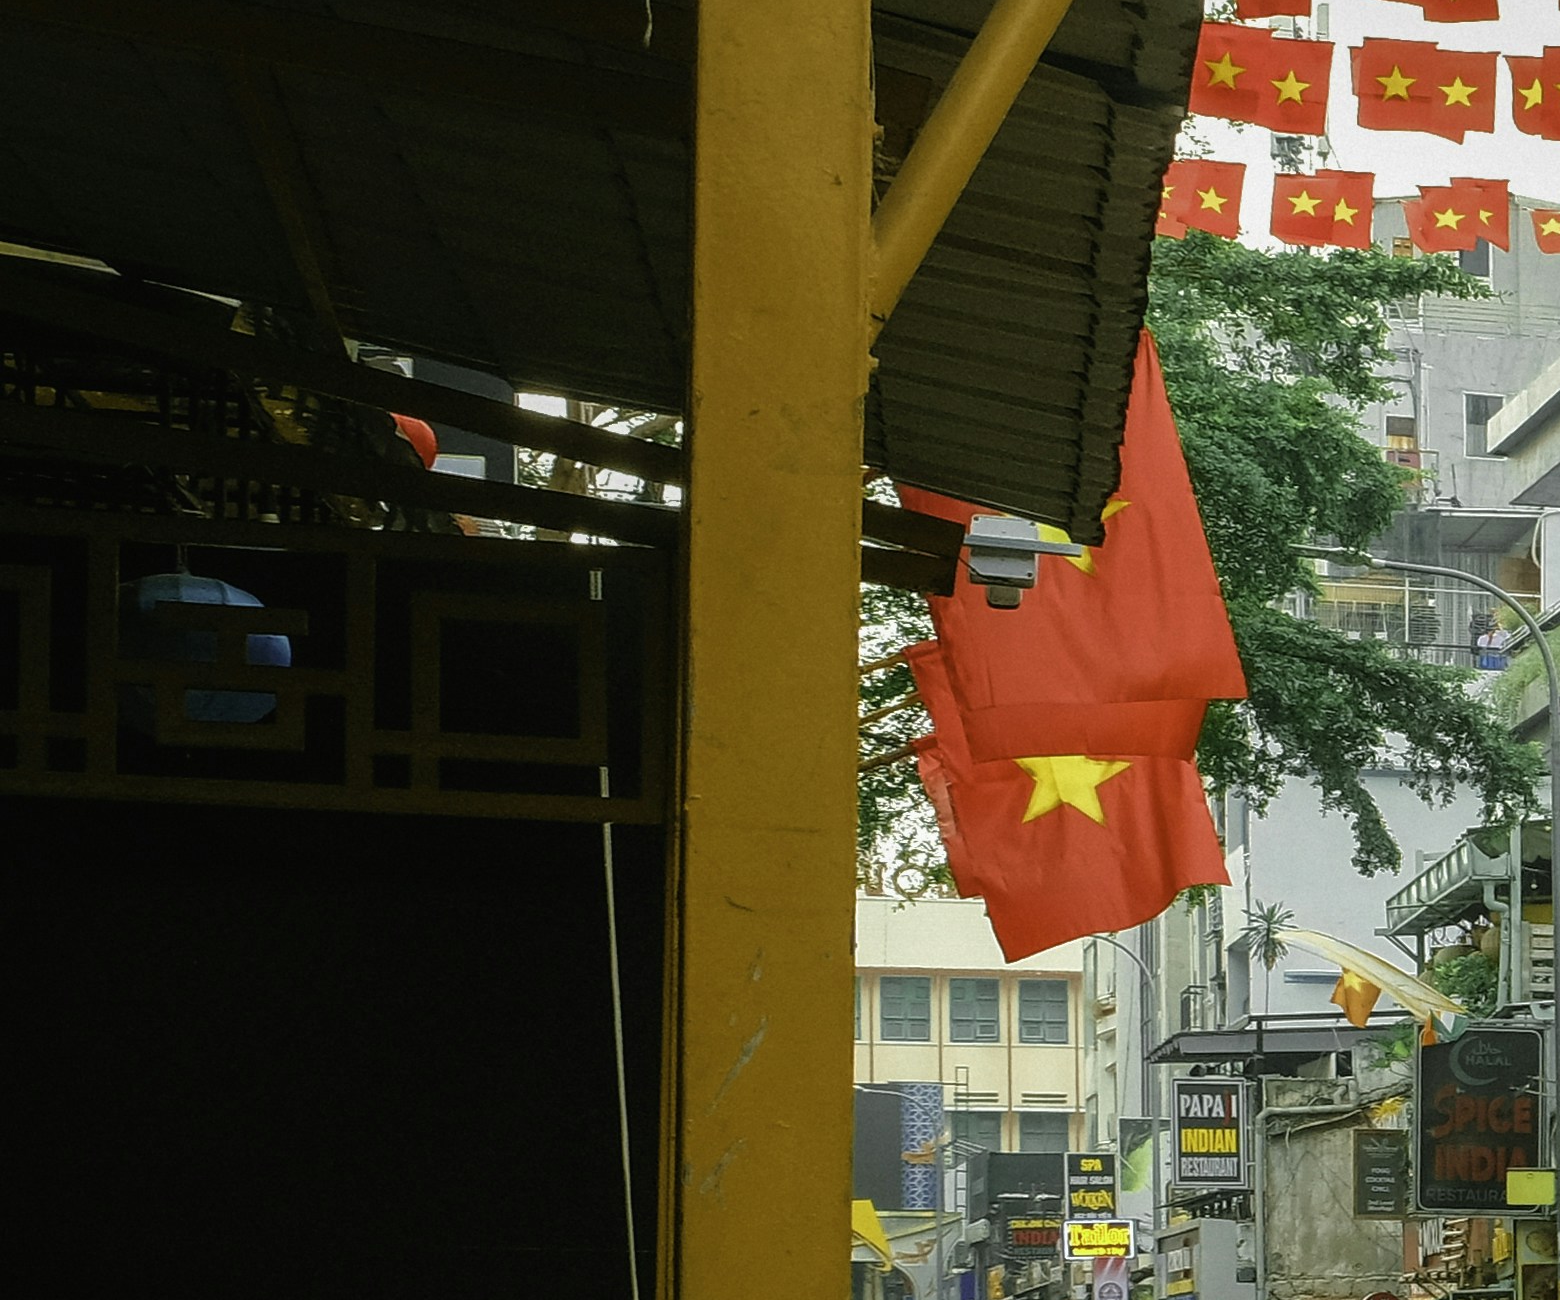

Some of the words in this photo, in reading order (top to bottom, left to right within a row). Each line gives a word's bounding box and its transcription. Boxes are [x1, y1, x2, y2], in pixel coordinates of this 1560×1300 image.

[1465, 1055, 1512, 1067] HALAL
[1432, 1083, 1533, 1139] SPICE
[1181, 1128, 1237, 1153] INDIAN
[1180, 1157, 1238, 1178] RESTAURANT
